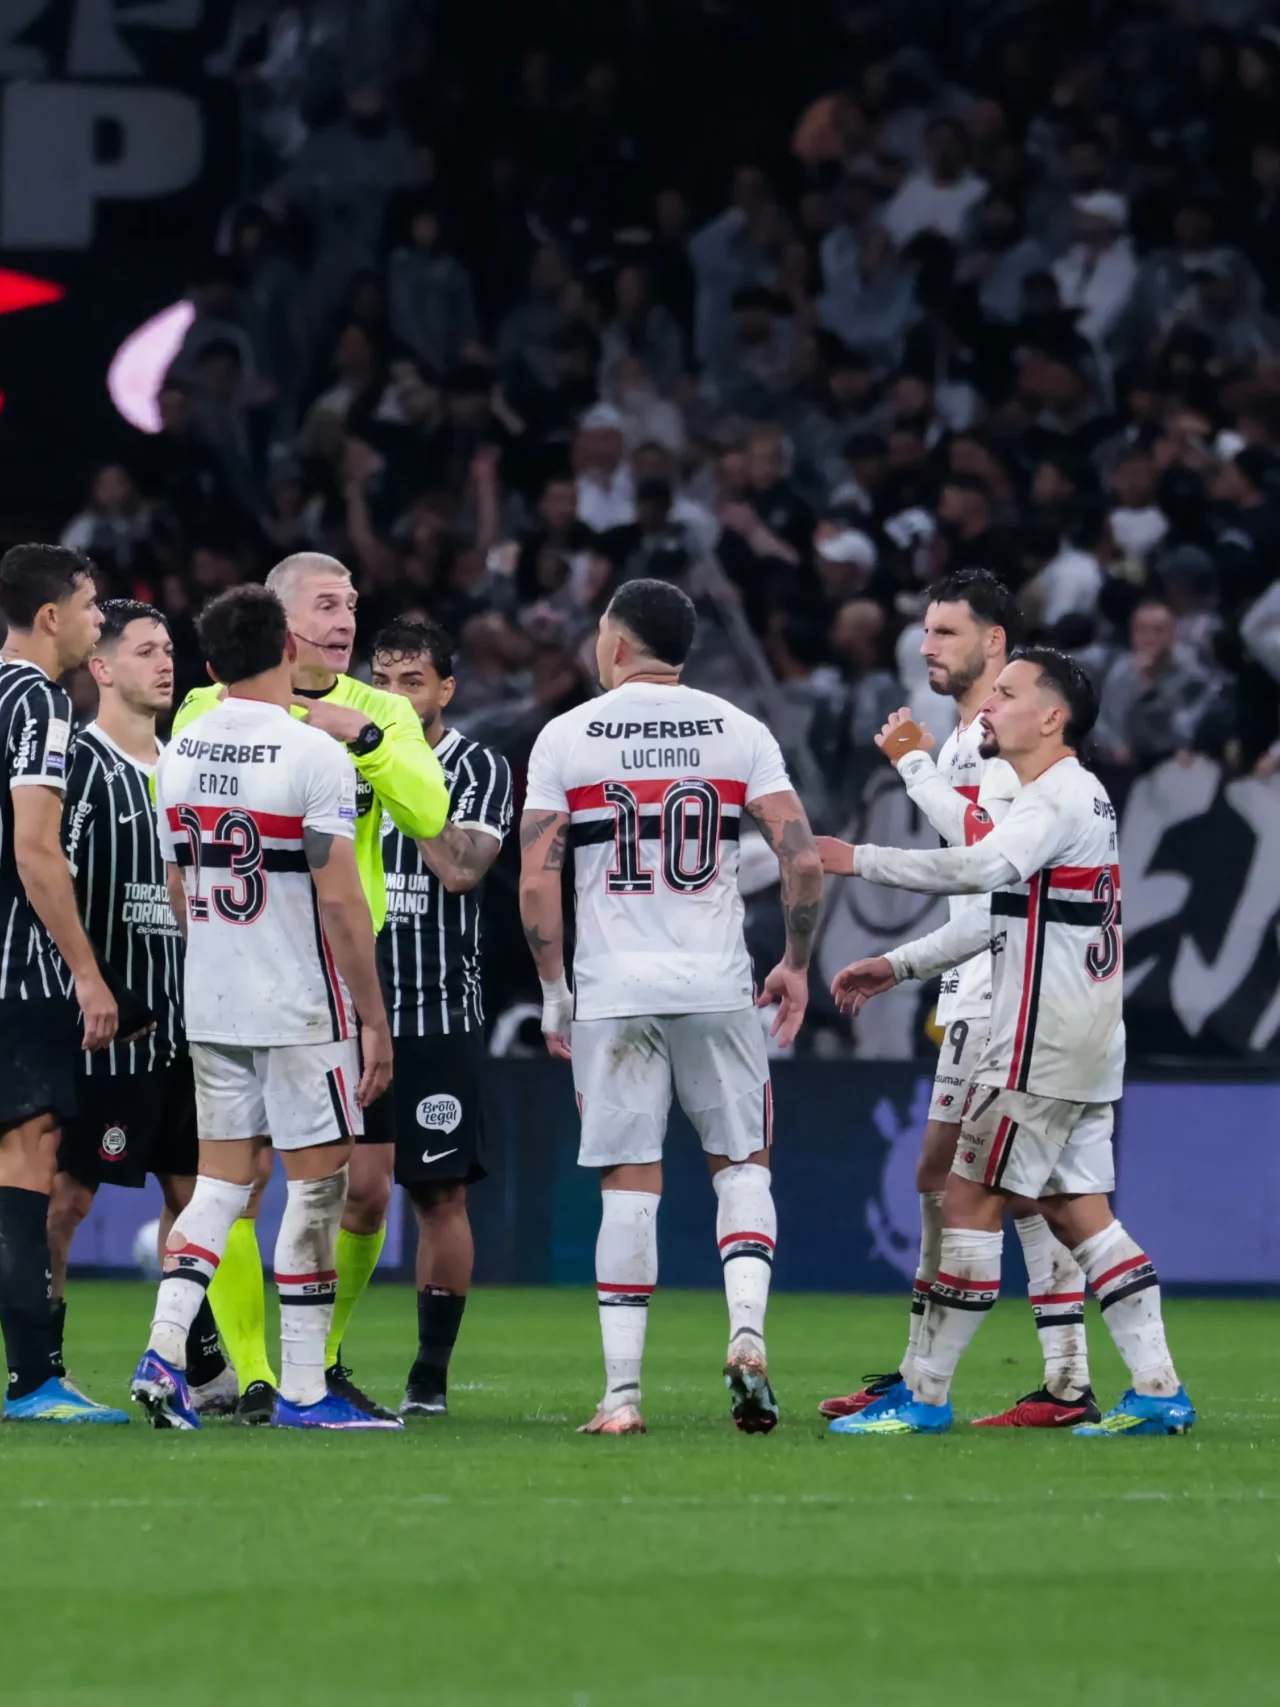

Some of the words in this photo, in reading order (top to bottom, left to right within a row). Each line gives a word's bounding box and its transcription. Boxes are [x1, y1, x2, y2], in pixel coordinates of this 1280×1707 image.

[586, 718, 725, 739] SUPERBET
[176, 737, 282, 764] SUPERBET
[621, 748, 701, 770] LUCIANO
[199, 773, 239, 796] ENZO
[602, 777, 720, 895] 10
[124, 882, 161, 904] TORÇA
[408, 874, 430, 892] UM
[949, 1020, 970, 1066] 9
[425, 1109, 458, 1126] Legal
[934, 1282, 995, 1301] SPFC
